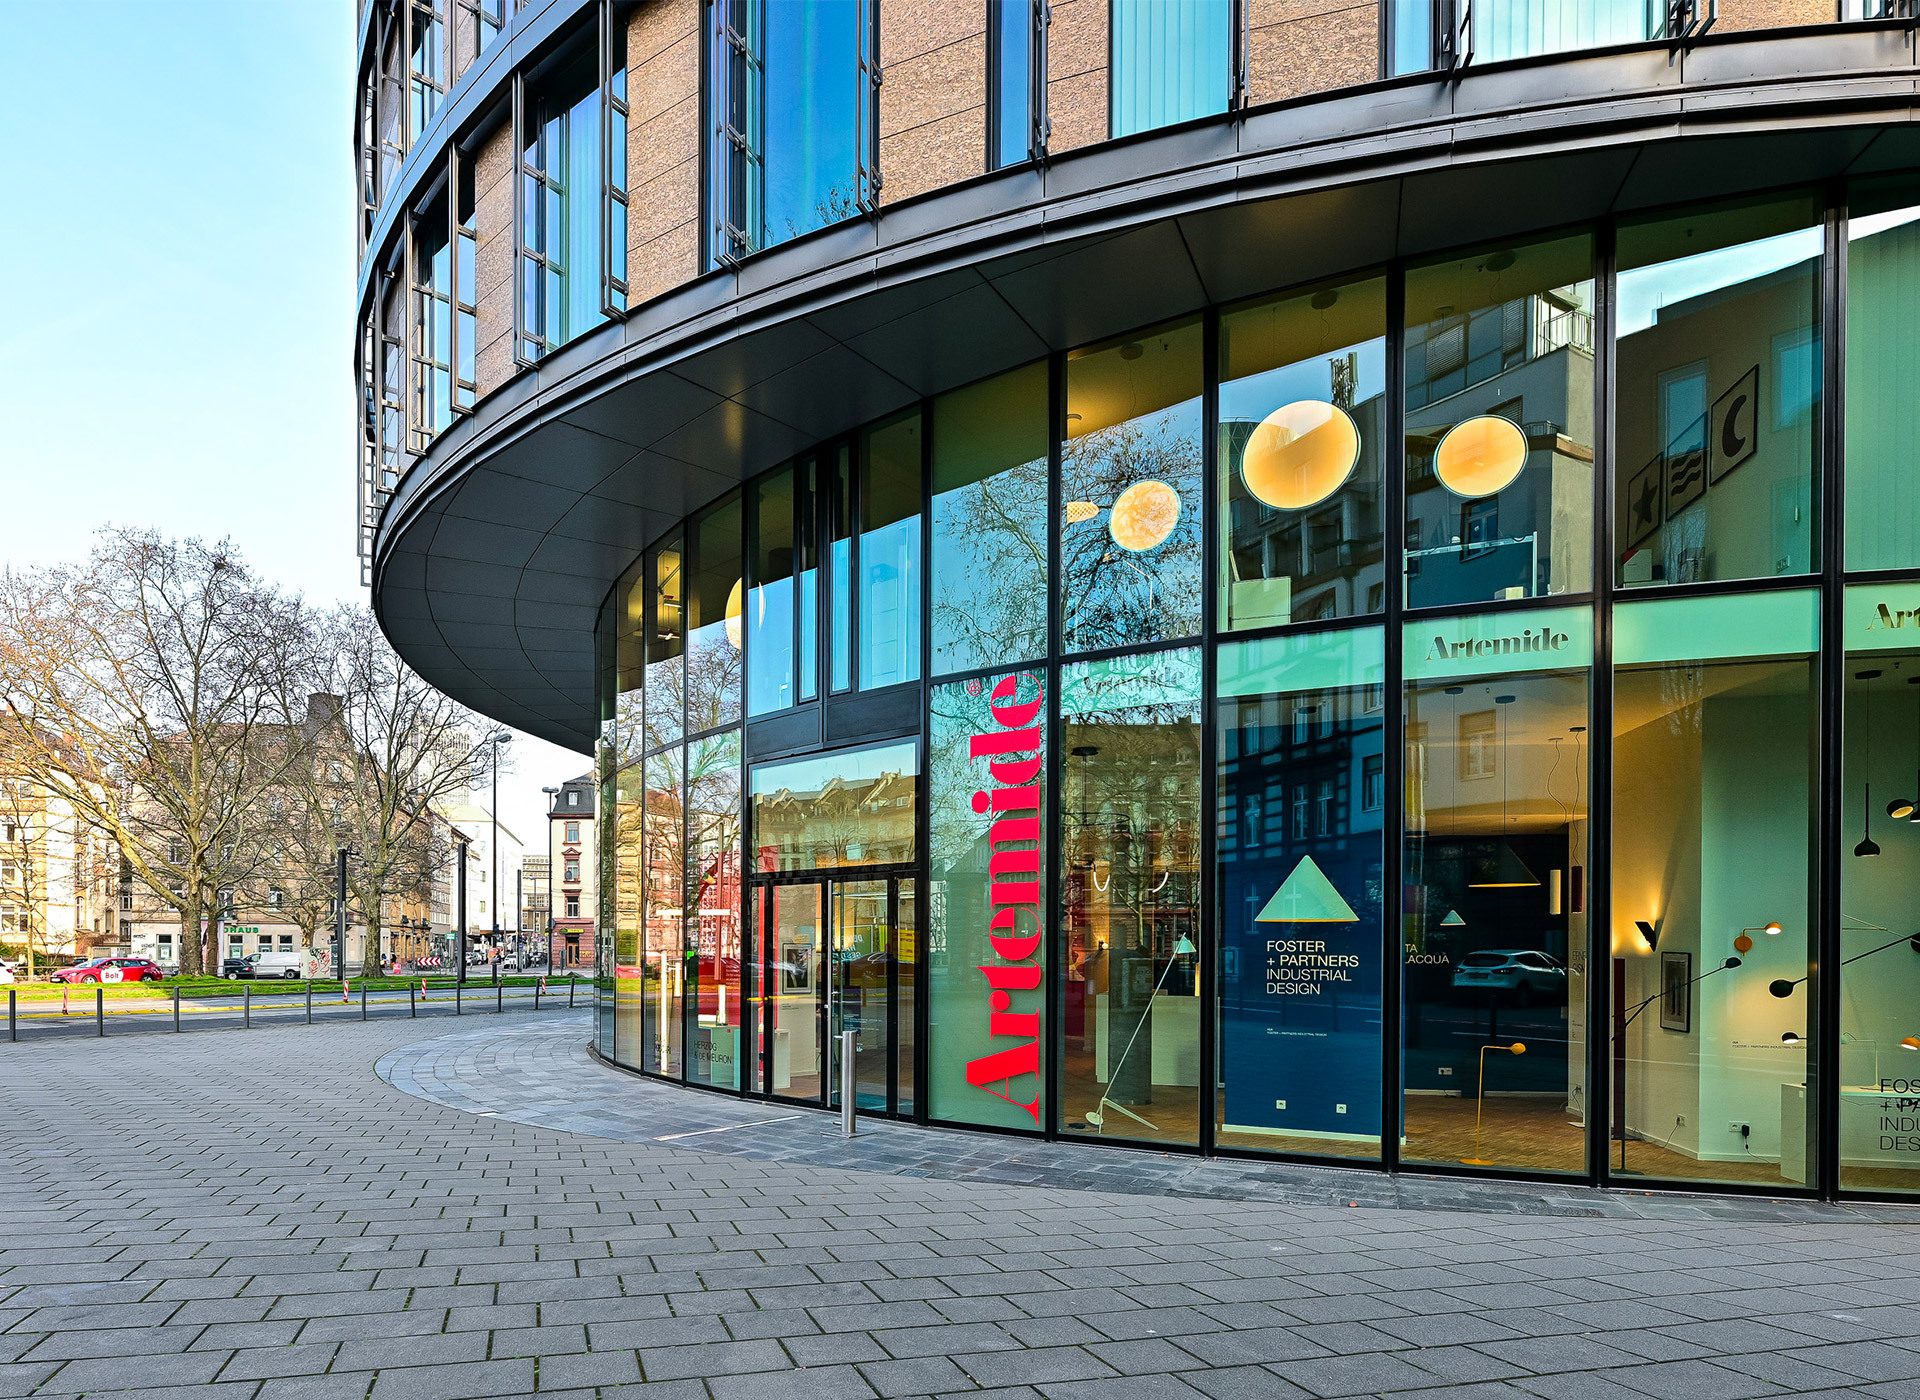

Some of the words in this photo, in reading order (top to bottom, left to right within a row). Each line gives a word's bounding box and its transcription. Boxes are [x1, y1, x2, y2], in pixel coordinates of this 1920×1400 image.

[1426, 627, 1569, 660] Artemide
[966, 673, 1043, 1127] Artemide
[1266, 940, 1326, 952] FOSTER
[1280, 954, 1360, 968] PARTNERS
[1266, 968, 1353, 982] INDUSTRIAL
[1266, 982, 1321, 995] DESIGN
[693, 1039, 718, 1052] HERZOG
[1880, 1116, 1920, 1132] IND
